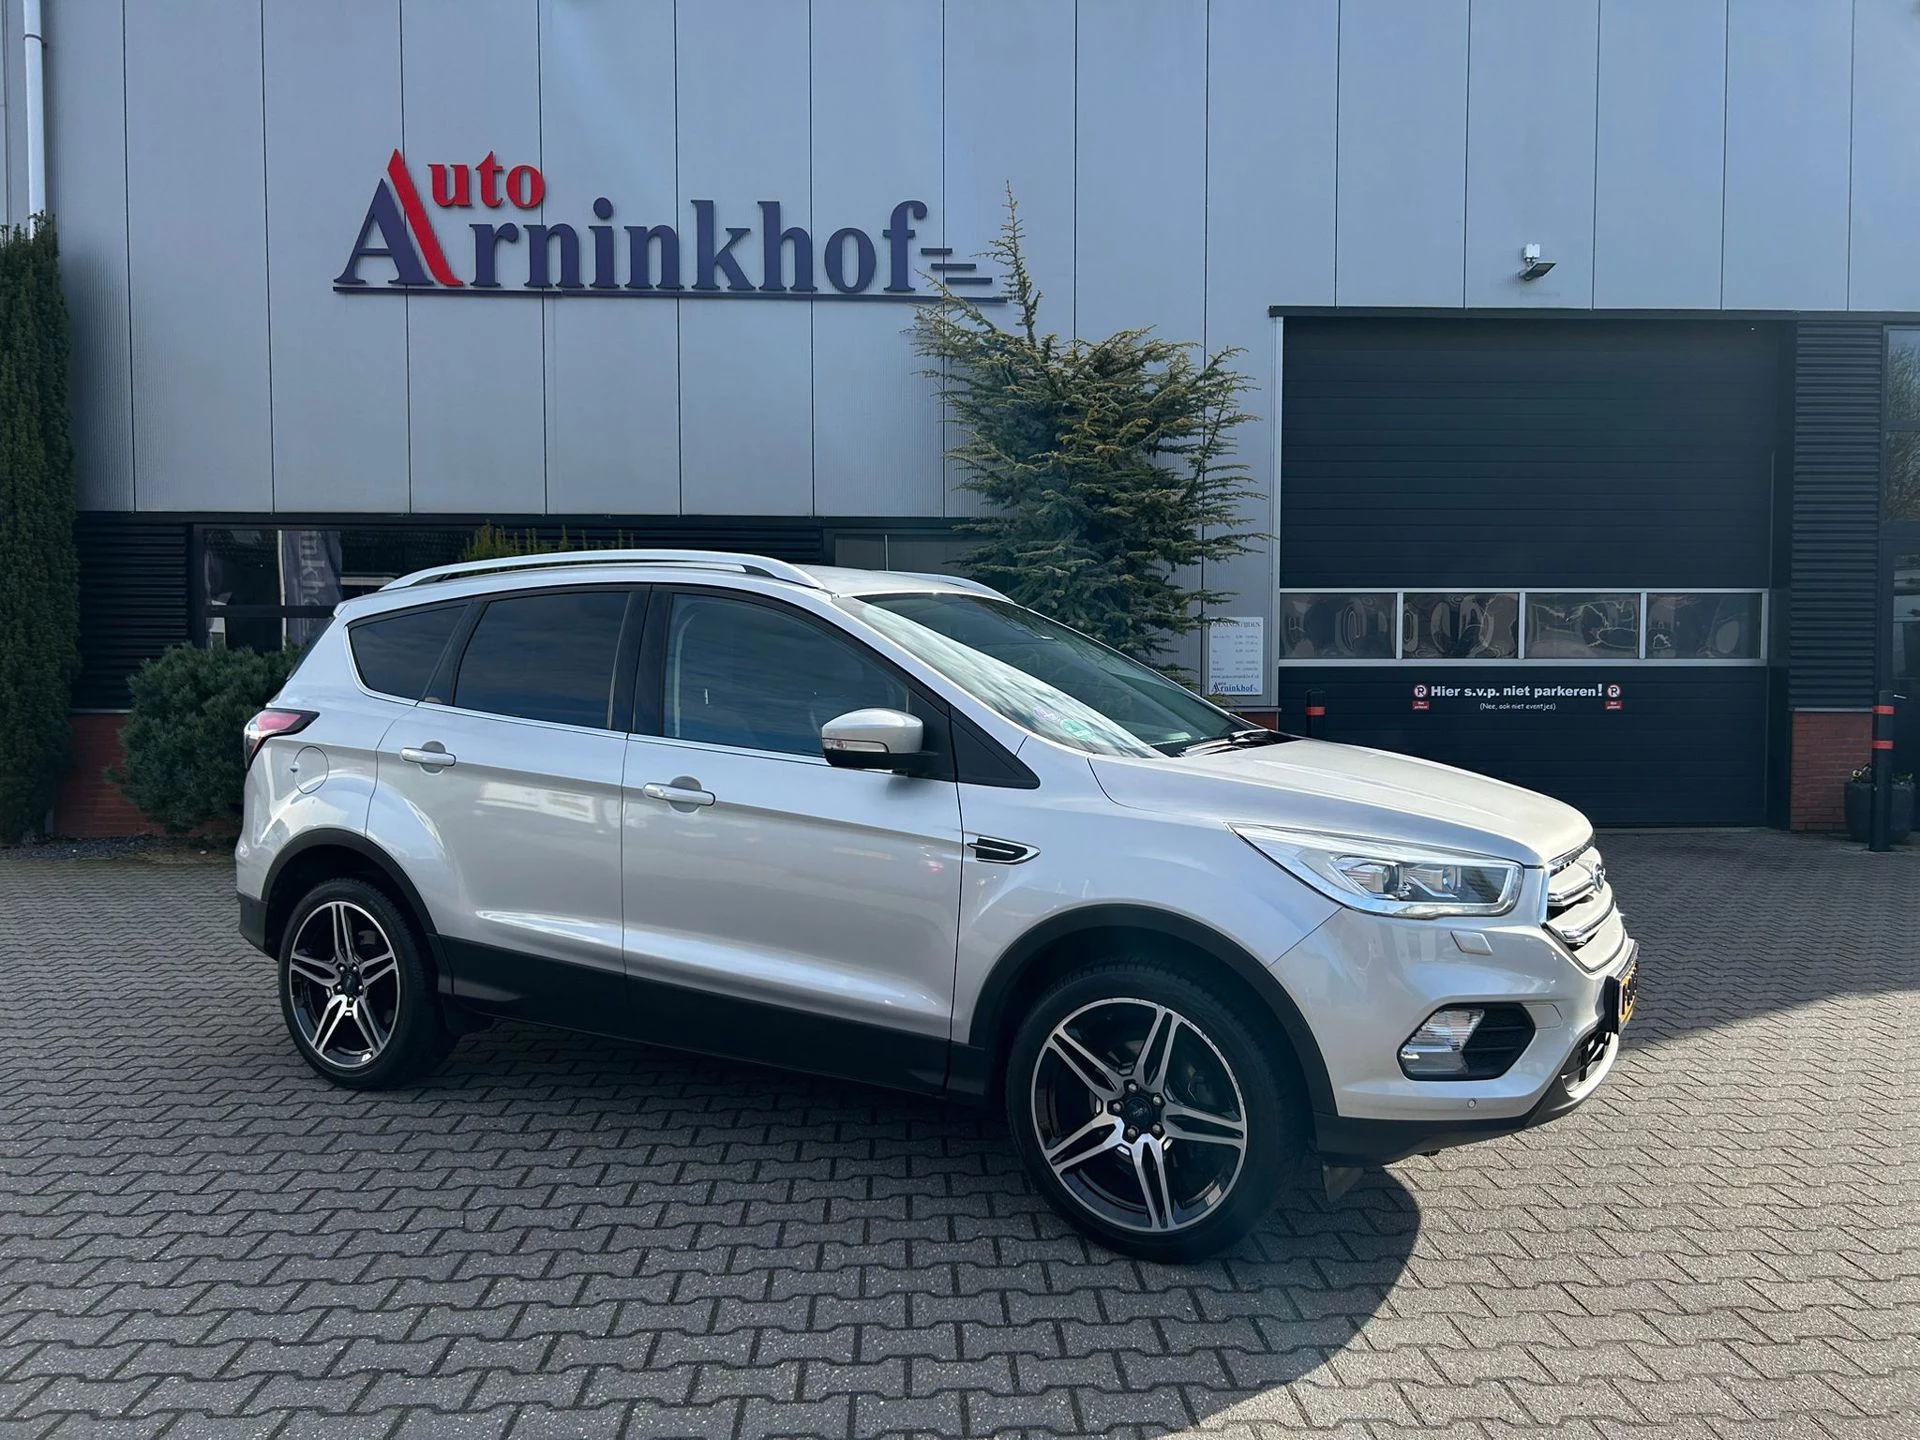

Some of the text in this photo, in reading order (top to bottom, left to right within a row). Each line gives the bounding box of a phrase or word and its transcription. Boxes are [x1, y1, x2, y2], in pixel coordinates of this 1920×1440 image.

[334, 176, 928, 293] Arninkhof
[1430, 683, 1603, 699] Hier s.v.p. niet parkeren!
[1480, 702, 1498, 710] (Nee,
[1525, 702, 1556, 711] eventjes)
